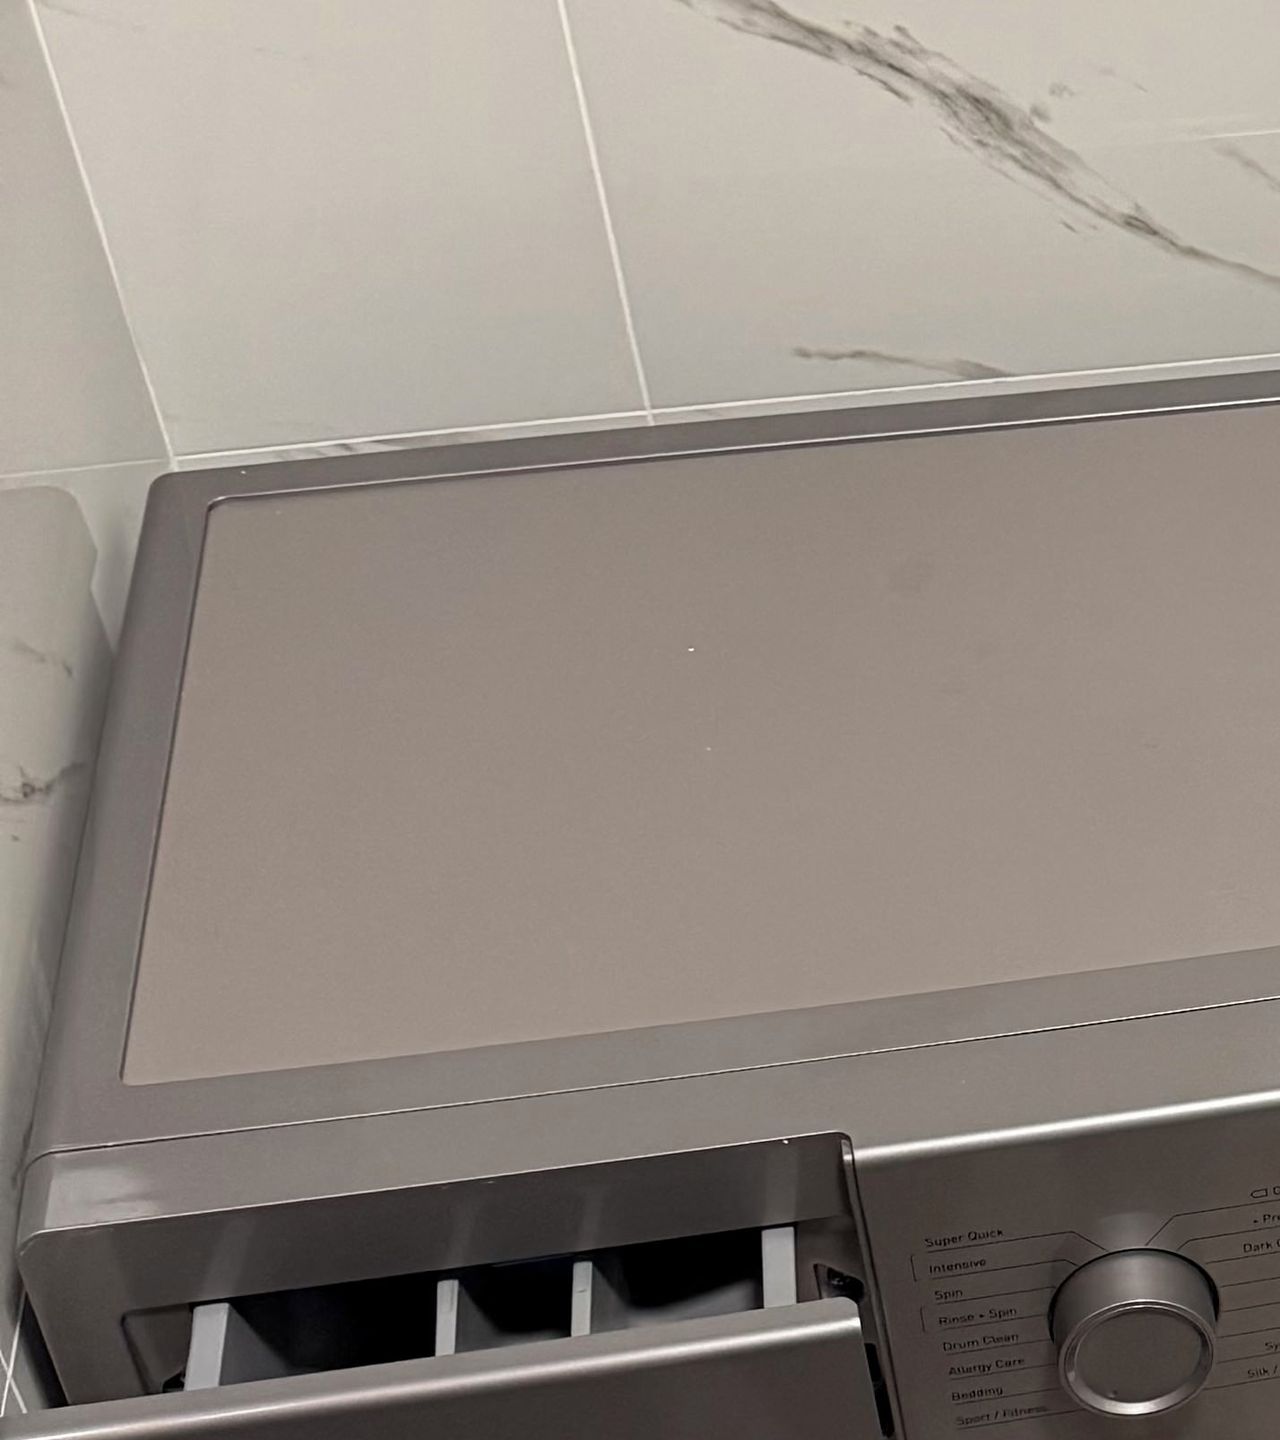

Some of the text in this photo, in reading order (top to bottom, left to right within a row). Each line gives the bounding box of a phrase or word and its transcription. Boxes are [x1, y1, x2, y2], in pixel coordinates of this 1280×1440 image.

[924, 1228, 1004, 1249] Super Quick
[1243, 1241, 1273, 1254] Dark
[929, 1257, 987, 1275] Intensive
[934, 1288, 964, 1302] Spin
[938, 1312, 975, 1326] Rinse
[988, 1307, 1018, 1320] Spin
[942, 1333, 1020, 1352] Drum Clean
[948, 1357, 1025, 1376] Allergy Care
[951, 1386, 1004, 1402] Bedding
[955, 1413, 990, 1427] Sport
